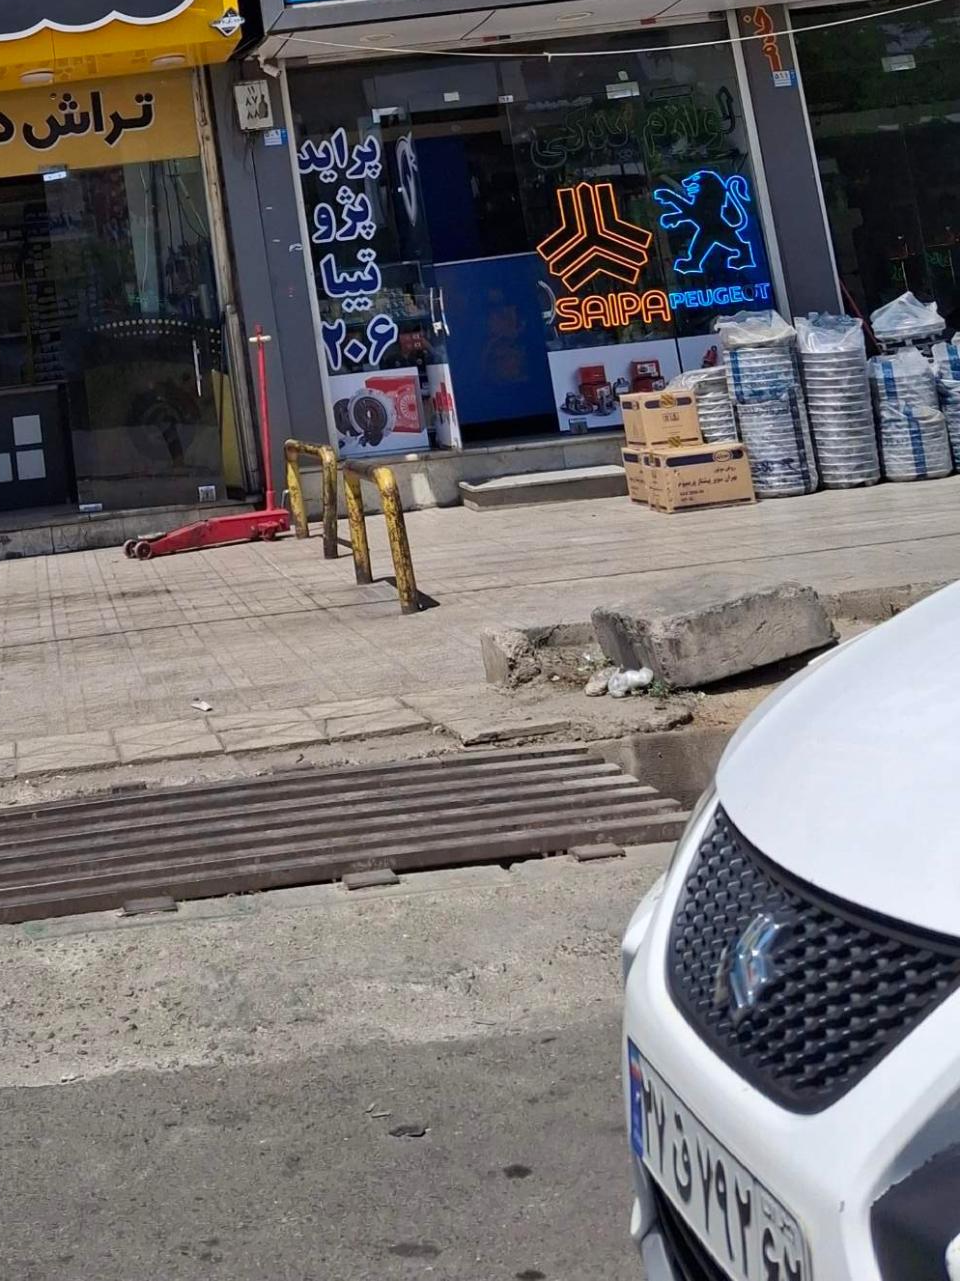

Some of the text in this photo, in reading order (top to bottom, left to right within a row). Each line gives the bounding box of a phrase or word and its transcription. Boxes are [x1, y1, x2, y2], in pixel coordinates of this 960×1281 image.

[21, 91, 154, 150] تراش
[298, 127, 383, 183] پراید
[312, 185, 377, 244] پژو
[320, 248, 382, 313] تیبا
[555, 282, 770, 331] SAIPA PEUGEOT
[321, 313, 398, 371] ۲۰۶
